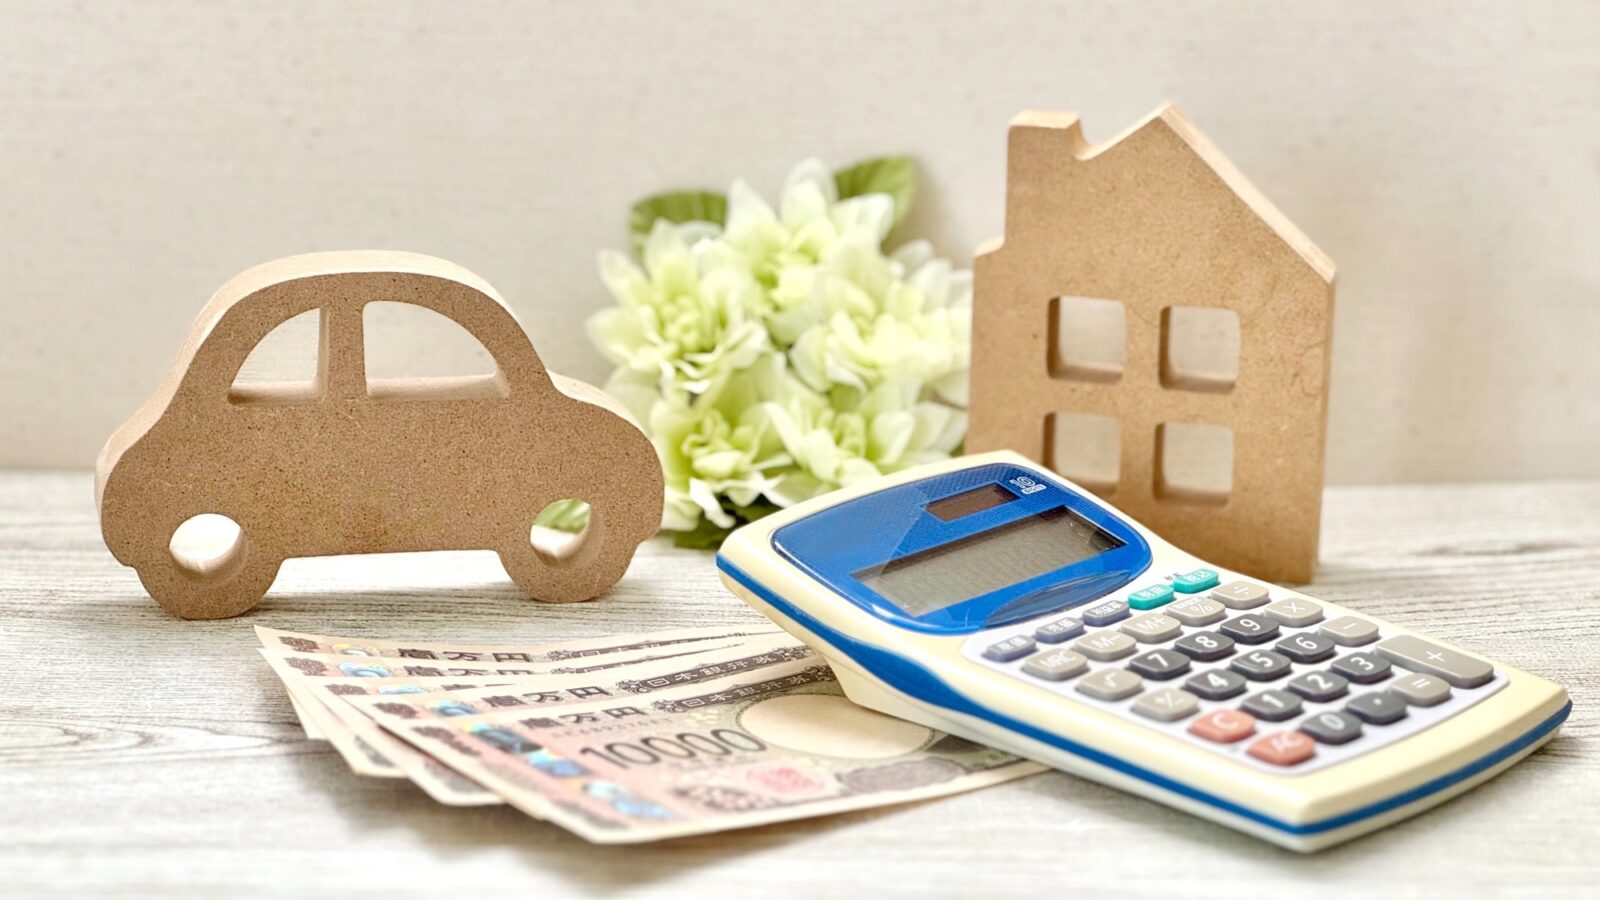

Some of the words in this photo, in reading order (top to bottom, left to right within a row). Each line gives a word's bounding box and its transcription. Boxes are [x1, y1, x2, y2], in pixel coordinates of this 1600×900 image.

[1239, 618, 1261, 631] 9
[1195, 636, 1218, 648] 8
[1295, 636, 1318, 650] 6
[1147, 653, 1170, 668] 7
[1250, 653, 1273, 668] 5
[1350, 656, 1375, 671] 3
[1207, 672, 1229, 687] 4
[1306, 674, 1333, 690] 2
[1261, 693, 1285, 709] 1
[1211, 712, 1240, 730] C
[1319, 713, 1346, 730] 0
[579, 728, 768, 770] 10000
